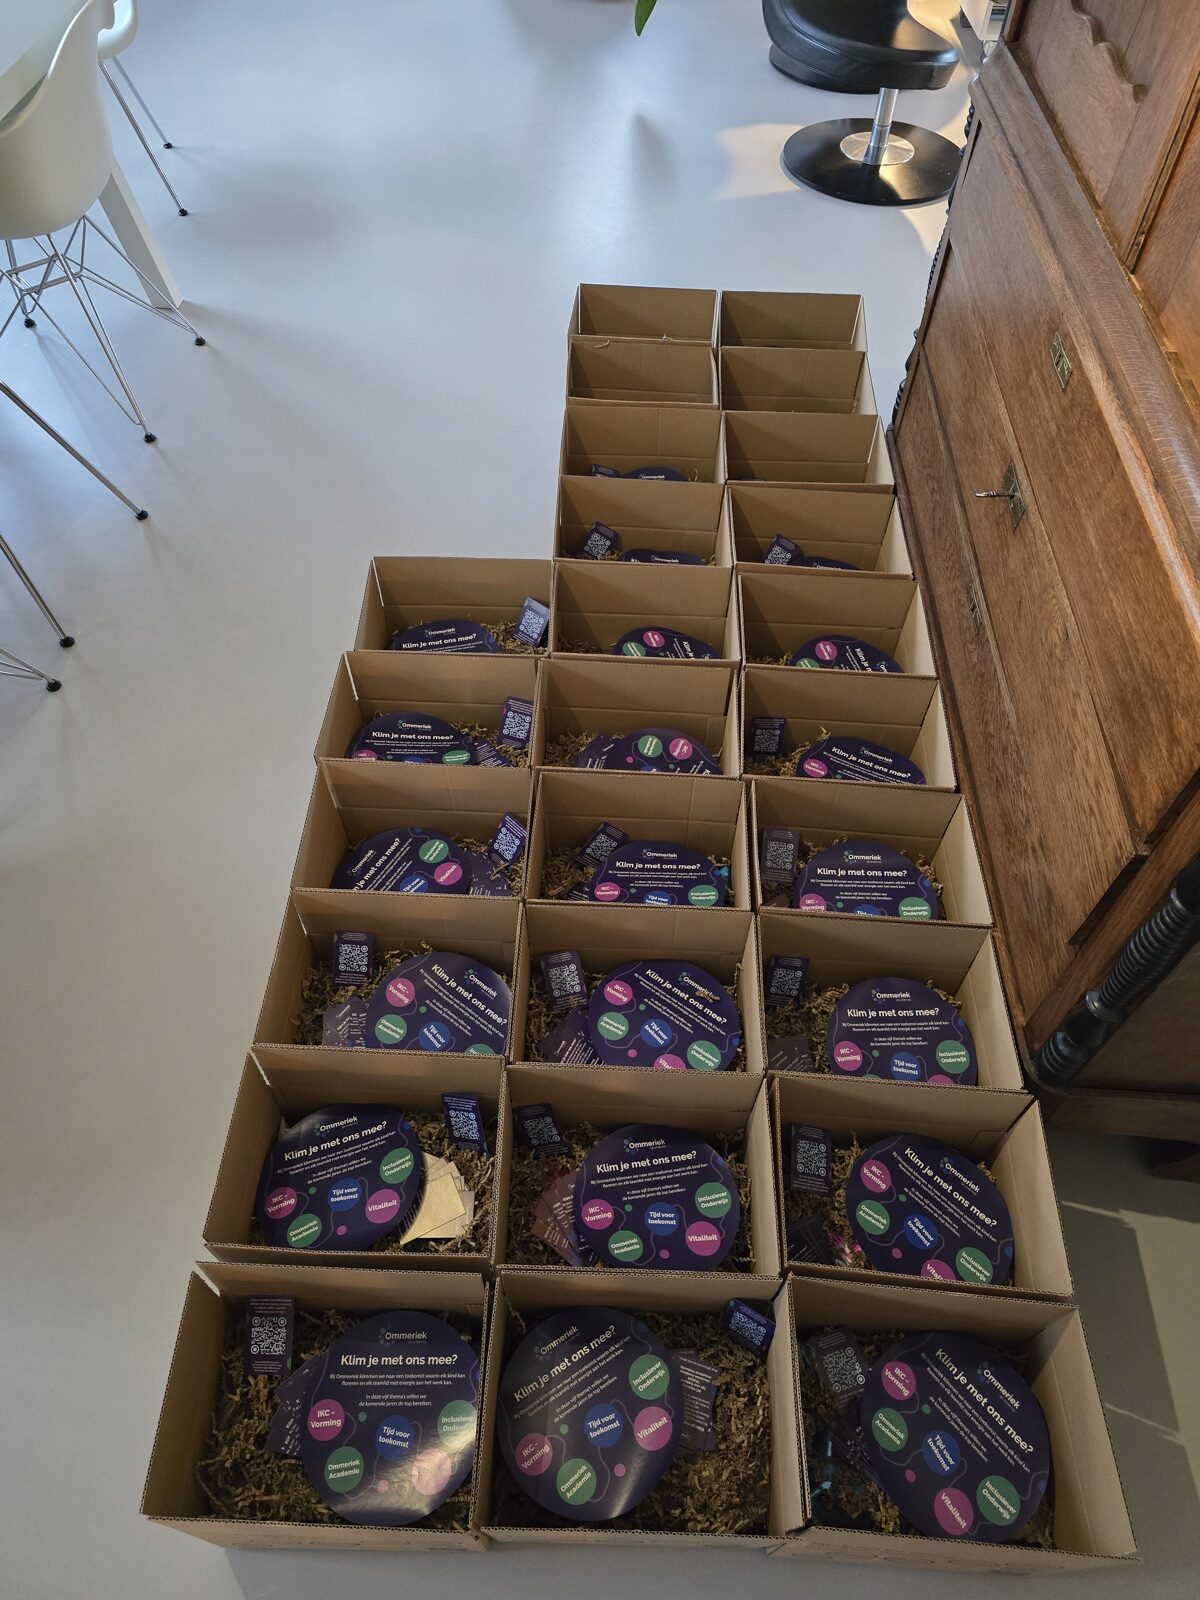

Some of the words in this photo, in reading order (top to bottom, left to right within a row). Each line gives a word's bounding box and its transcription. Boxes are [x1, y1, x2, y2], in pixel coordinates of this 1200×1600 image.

[458, 633, 477, 641] mee?
[832, 747, 849, 758] Klim
[848, 753, 857, 761] je
[858, 758, 874, 768] met
[874, 764, 888, 772] ons
[889, 769, 911, 778] mee?
[356, 880, 365, 888] je
[364, 867, 377, 880] met
[376, 856, 387, 867] ons
[385, 837, 401, 855] mee?
[635, 862, 643, 870] je
[838, 868, 846, 876] je
[432, 964, 449, 981] Klim
[446, 978, 457, 988] je
[456, 985, 472, 1000] met
[471, 998, 486, 1011] ons
[485, 1007, 507, 1026] mee?
[469, 974, 498, 998] Ommeriek
[646, 969, 664, 983] Klim
[662, 981, 672, 989] je
[672, 986, 689, 1000] met
[688, 998, 703, 1010] ons
[703, 1007, 727, 1024] mee?
[847, 1009, 867, 1017] Klim
[868, 1009, 876, 1018] je
[916, 1008, 939, 1016] mee?
[284, 1148, 308, 1161] Klim
[308, 1145, 319, 1156] je
[320, 1139, 341, 1151] met
[342, 1132, 360, 1143] ons
[361, 1121, 387, 1137] mee?
[596, 1163, 618, 1174] Klim
[620, 1161, 629, 1172] je
[631, 1158, 651, 1168] met
[652, 1156, 670, 1164] ons
[672, 1151, 697, 1162] mee?
[904, 1148, 924, 1169] Klim
[922, 1165, 934, 1177] je
[933, 1174, 952, 1193] met
[952, 1190, 969, 1207] ons
[969, 1204, 997, 1227] mee?
[540, 1326, 578, 1355] Ommeriek
[341, 1355, 366, 1365] Klim
[367, 1355, 378, 1367] je
[381, 1355, 403, 1365] met
[406, 1356, 425, 1365] ons
[428, 1354, 458, 1364] mee?
[514, 1381, 539, 1402] Klim
[537, 1373, 549, 1388] je
[550, 1358, 572, 1377] met
[572, 1345, 590, 1362] ons
[590, 1325, 616, 1350] mee?
[633, 1361, 662, 1386] Inclusiever
[638, 1369, 666, 1391] Onderwijs
[885, 1369, 909, 1396] Vorming
[894, 1367, 906, 1380] IKC
[935, 1349, 958, 1374] Klim
[954, 1368, 968, 1385] je
[966, 1383, 988, 1407] met
[986, 1405, 1006, 1426] ons
[1004, 1423, 1034, 1453] mee?
[983, 1369, 1020, 1409] Ommeriek
[310, 1419, 341, 1428] Vorming
[383, 1427, 395, 1435] Tijd
[396, 1430, 410, 1438] voor
[588, 1417, 601, 1429] Tijd
[600, 1412, 616, 1424] voor
[589, 1420, 620, 1438] toekomst
[637, 1417, 668, 1439] Vitaliteit
[875, 1420, 900, 1445] Academie
[878, 1412, 904, 1440] Ommeriek
[379, 1436, 409, 1448] toekomst
[522, 1444, 534, 1456] IKC
[927, 1437, 950, 1472] toekomst
[934, 1435, 945, 1449] Tijd
[941, 1448, 955, 1465] voor
[328, 1460, 360, 1469] Ommeriek
[521, 1444, 550, 1469] Vorming
[329, 1469, 359, 1479] Academie
[560, 1465, 588, 1492] Ommeriek
[566, 1472, 592, 1499] Academie
[982, 1489, 1011, 1520] Onderwijs
[985, 1480, 1017, 1514] Inclusiever
[940, 1492, 967, 1528] Vitaliteit
